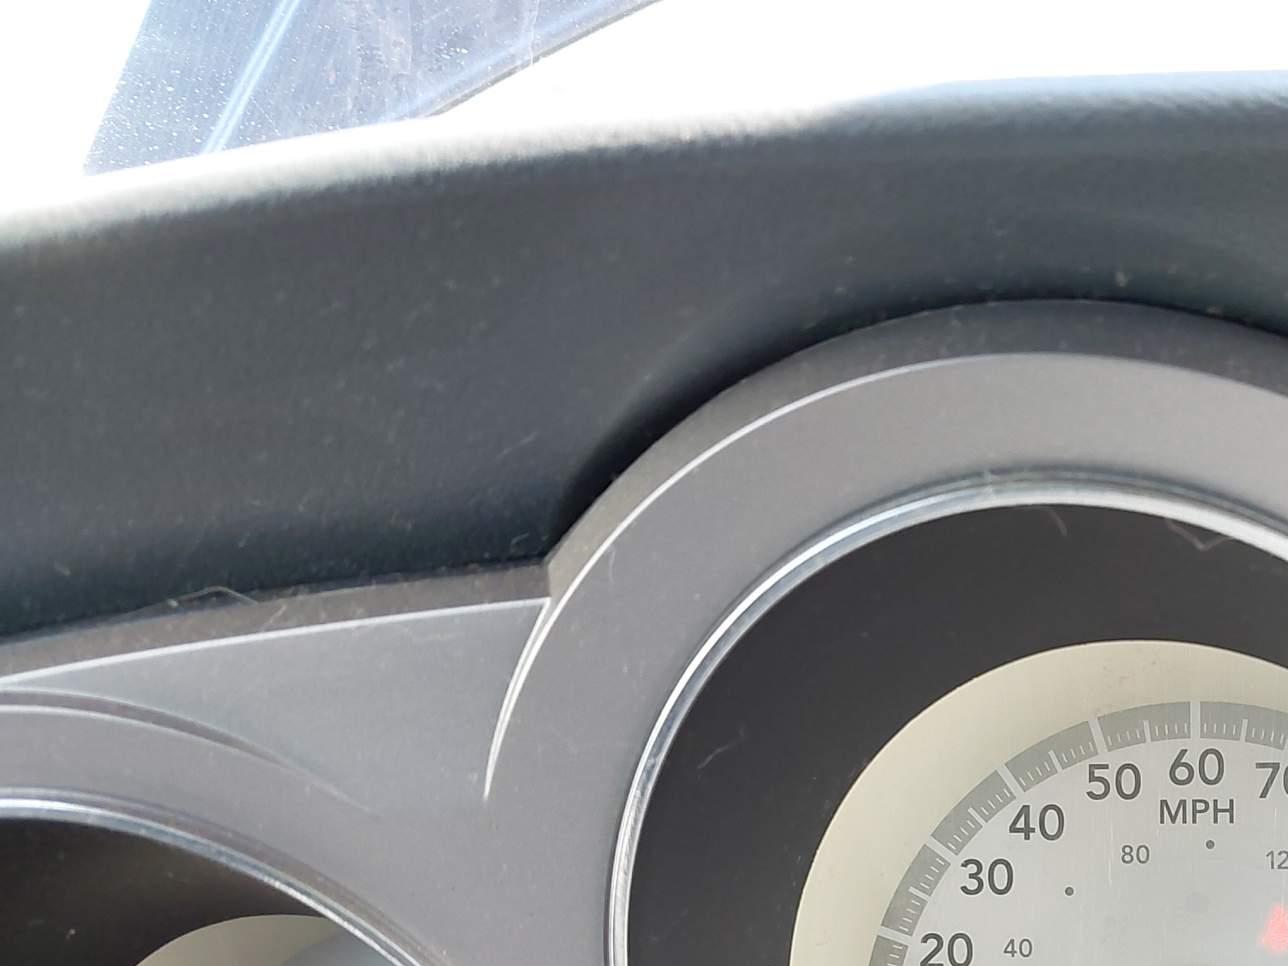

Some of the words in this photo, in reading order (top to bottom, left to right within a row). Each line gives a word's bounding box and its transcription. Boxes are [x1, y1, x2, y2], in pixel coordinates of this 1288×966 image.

[1086, 763, 1142, 800] 50
[1169, 748, 1225, 786] 60
[1008, 804, 1065, 841] 40
[1159, 799, 1235, 825] MPH
[1121, 845, 1150, 864] 80
[960, 858, 1014, 896] 30
[1003, 938, 1033, 957] 40
